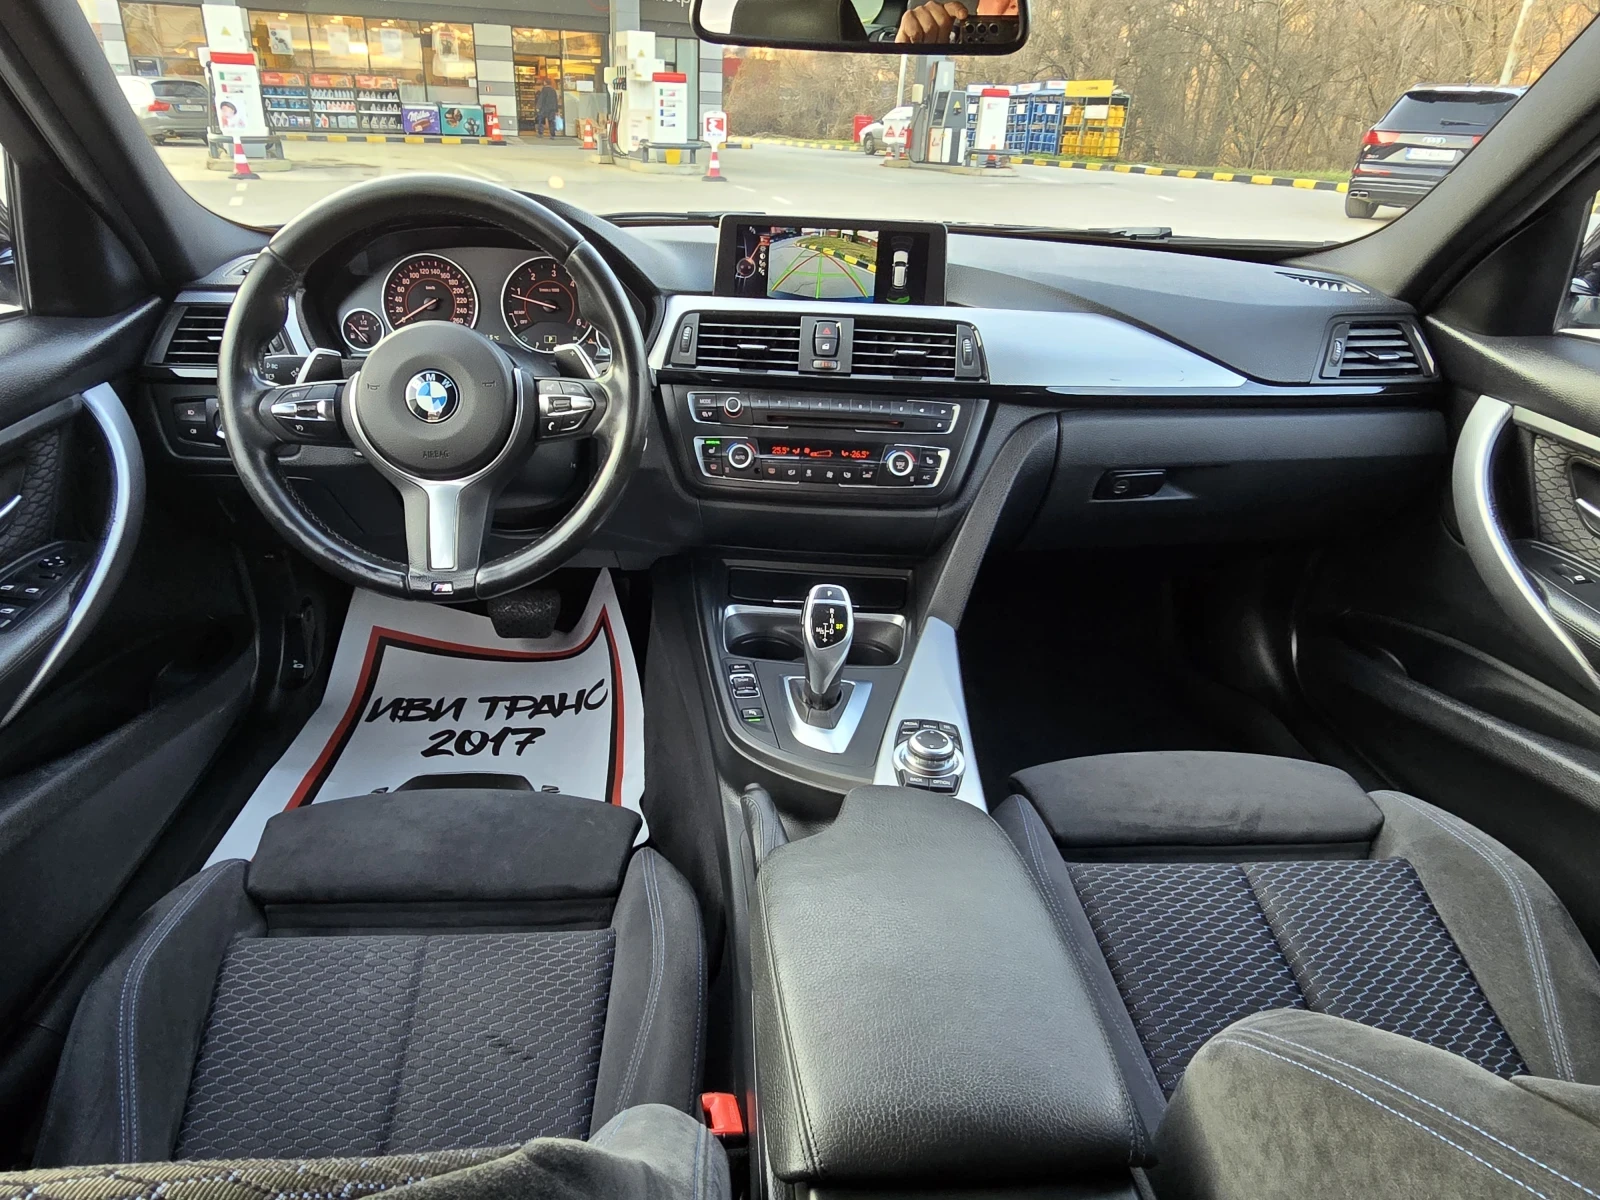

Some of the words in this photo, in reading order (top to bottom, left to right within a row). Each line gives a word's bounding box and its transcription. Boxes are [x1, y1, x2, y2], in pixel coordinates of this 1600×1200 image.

[407, 110, 430, 122] Milka
[531, 273, 536, 281] 2
[517, 287, 521, 295] 1
[576, 318, 581, 326] 6
[412, 373, 453, 390] BMW
[422, 450, 449, 459] AIRBAG
[365, 697, 468, 723] ИВИ
[478, 678, 608, 721] ТРАНС
[421, 726, 546, 757] 2017
